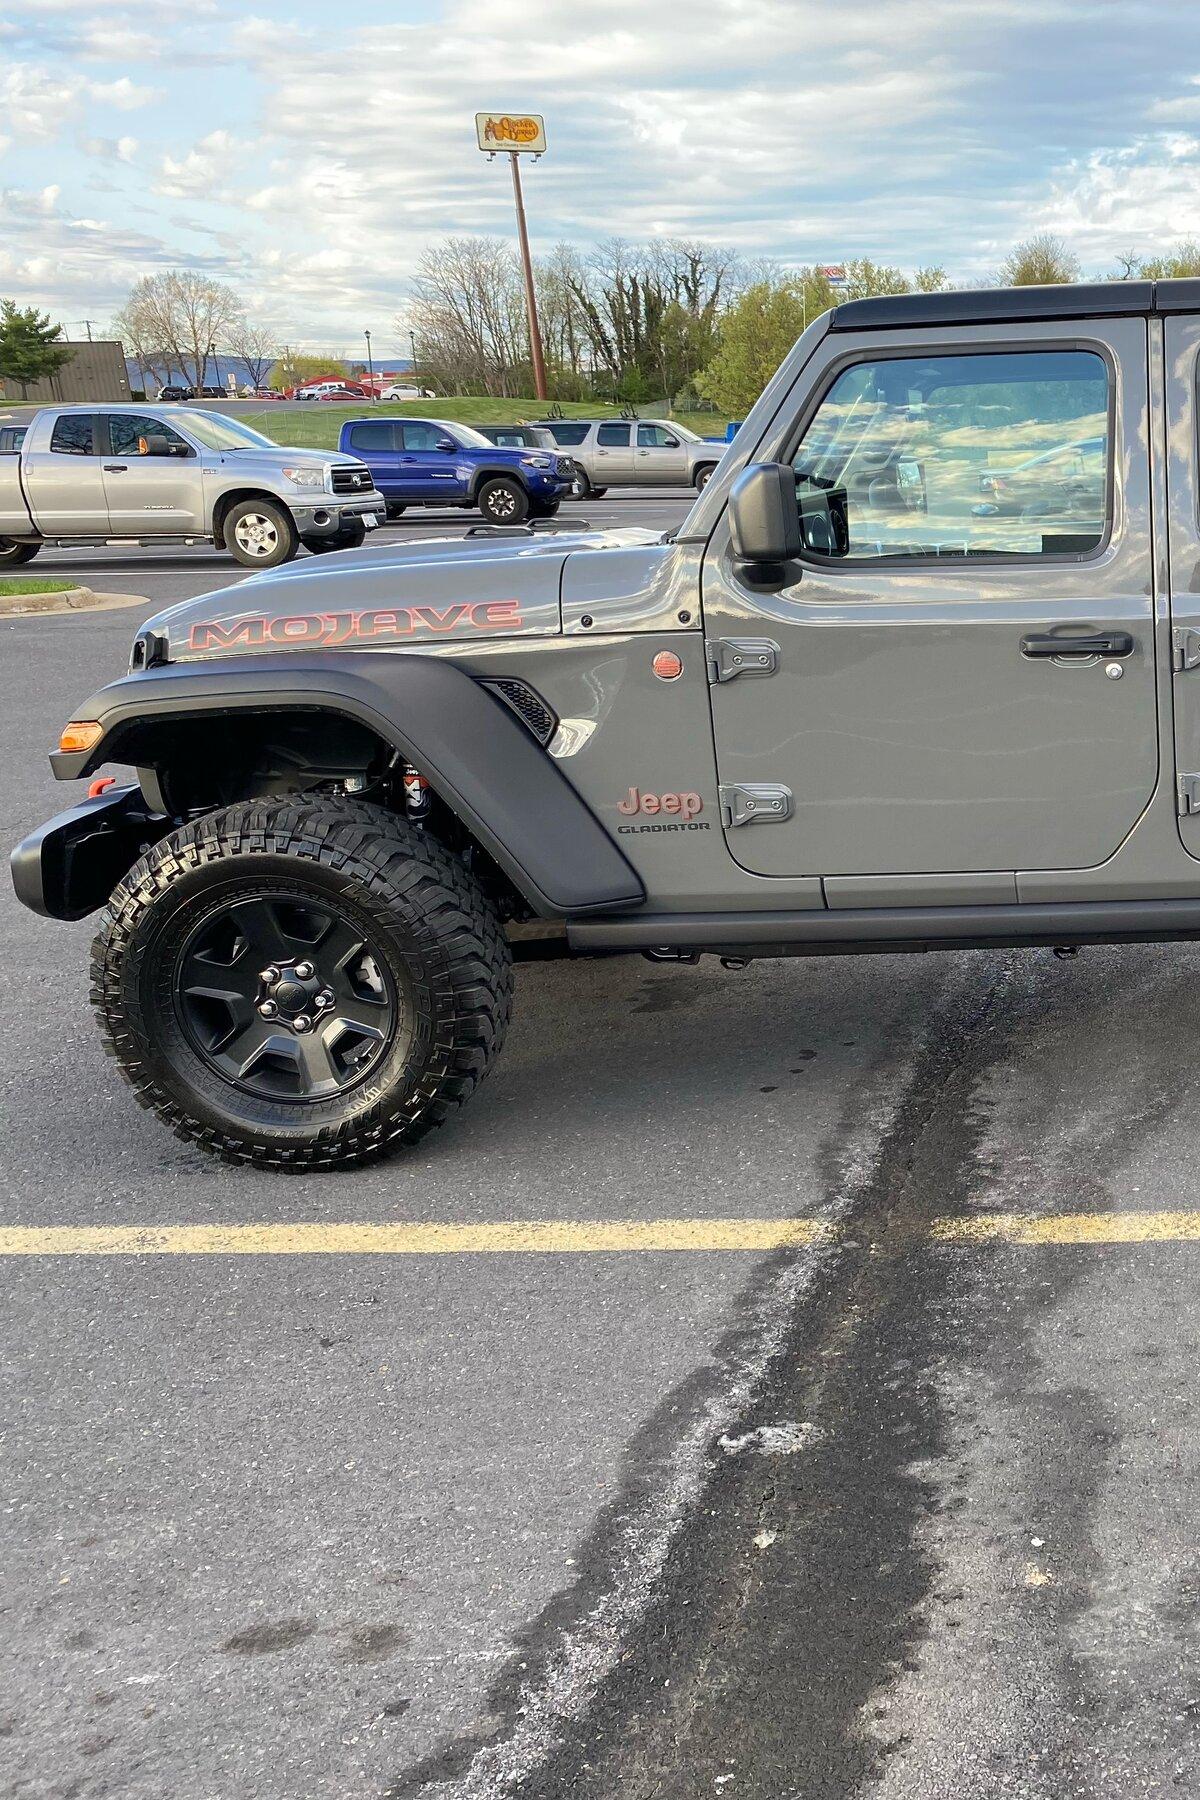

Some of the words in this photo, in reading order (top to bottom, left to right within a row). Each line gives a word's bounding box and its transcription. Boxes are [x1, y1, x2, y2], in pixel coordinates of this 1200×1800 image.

[189, 600, 523, 650] MOJAVE
[616, 787, 704, 821] Jeep
[617, 822, 712, 834] GLADIATOR
